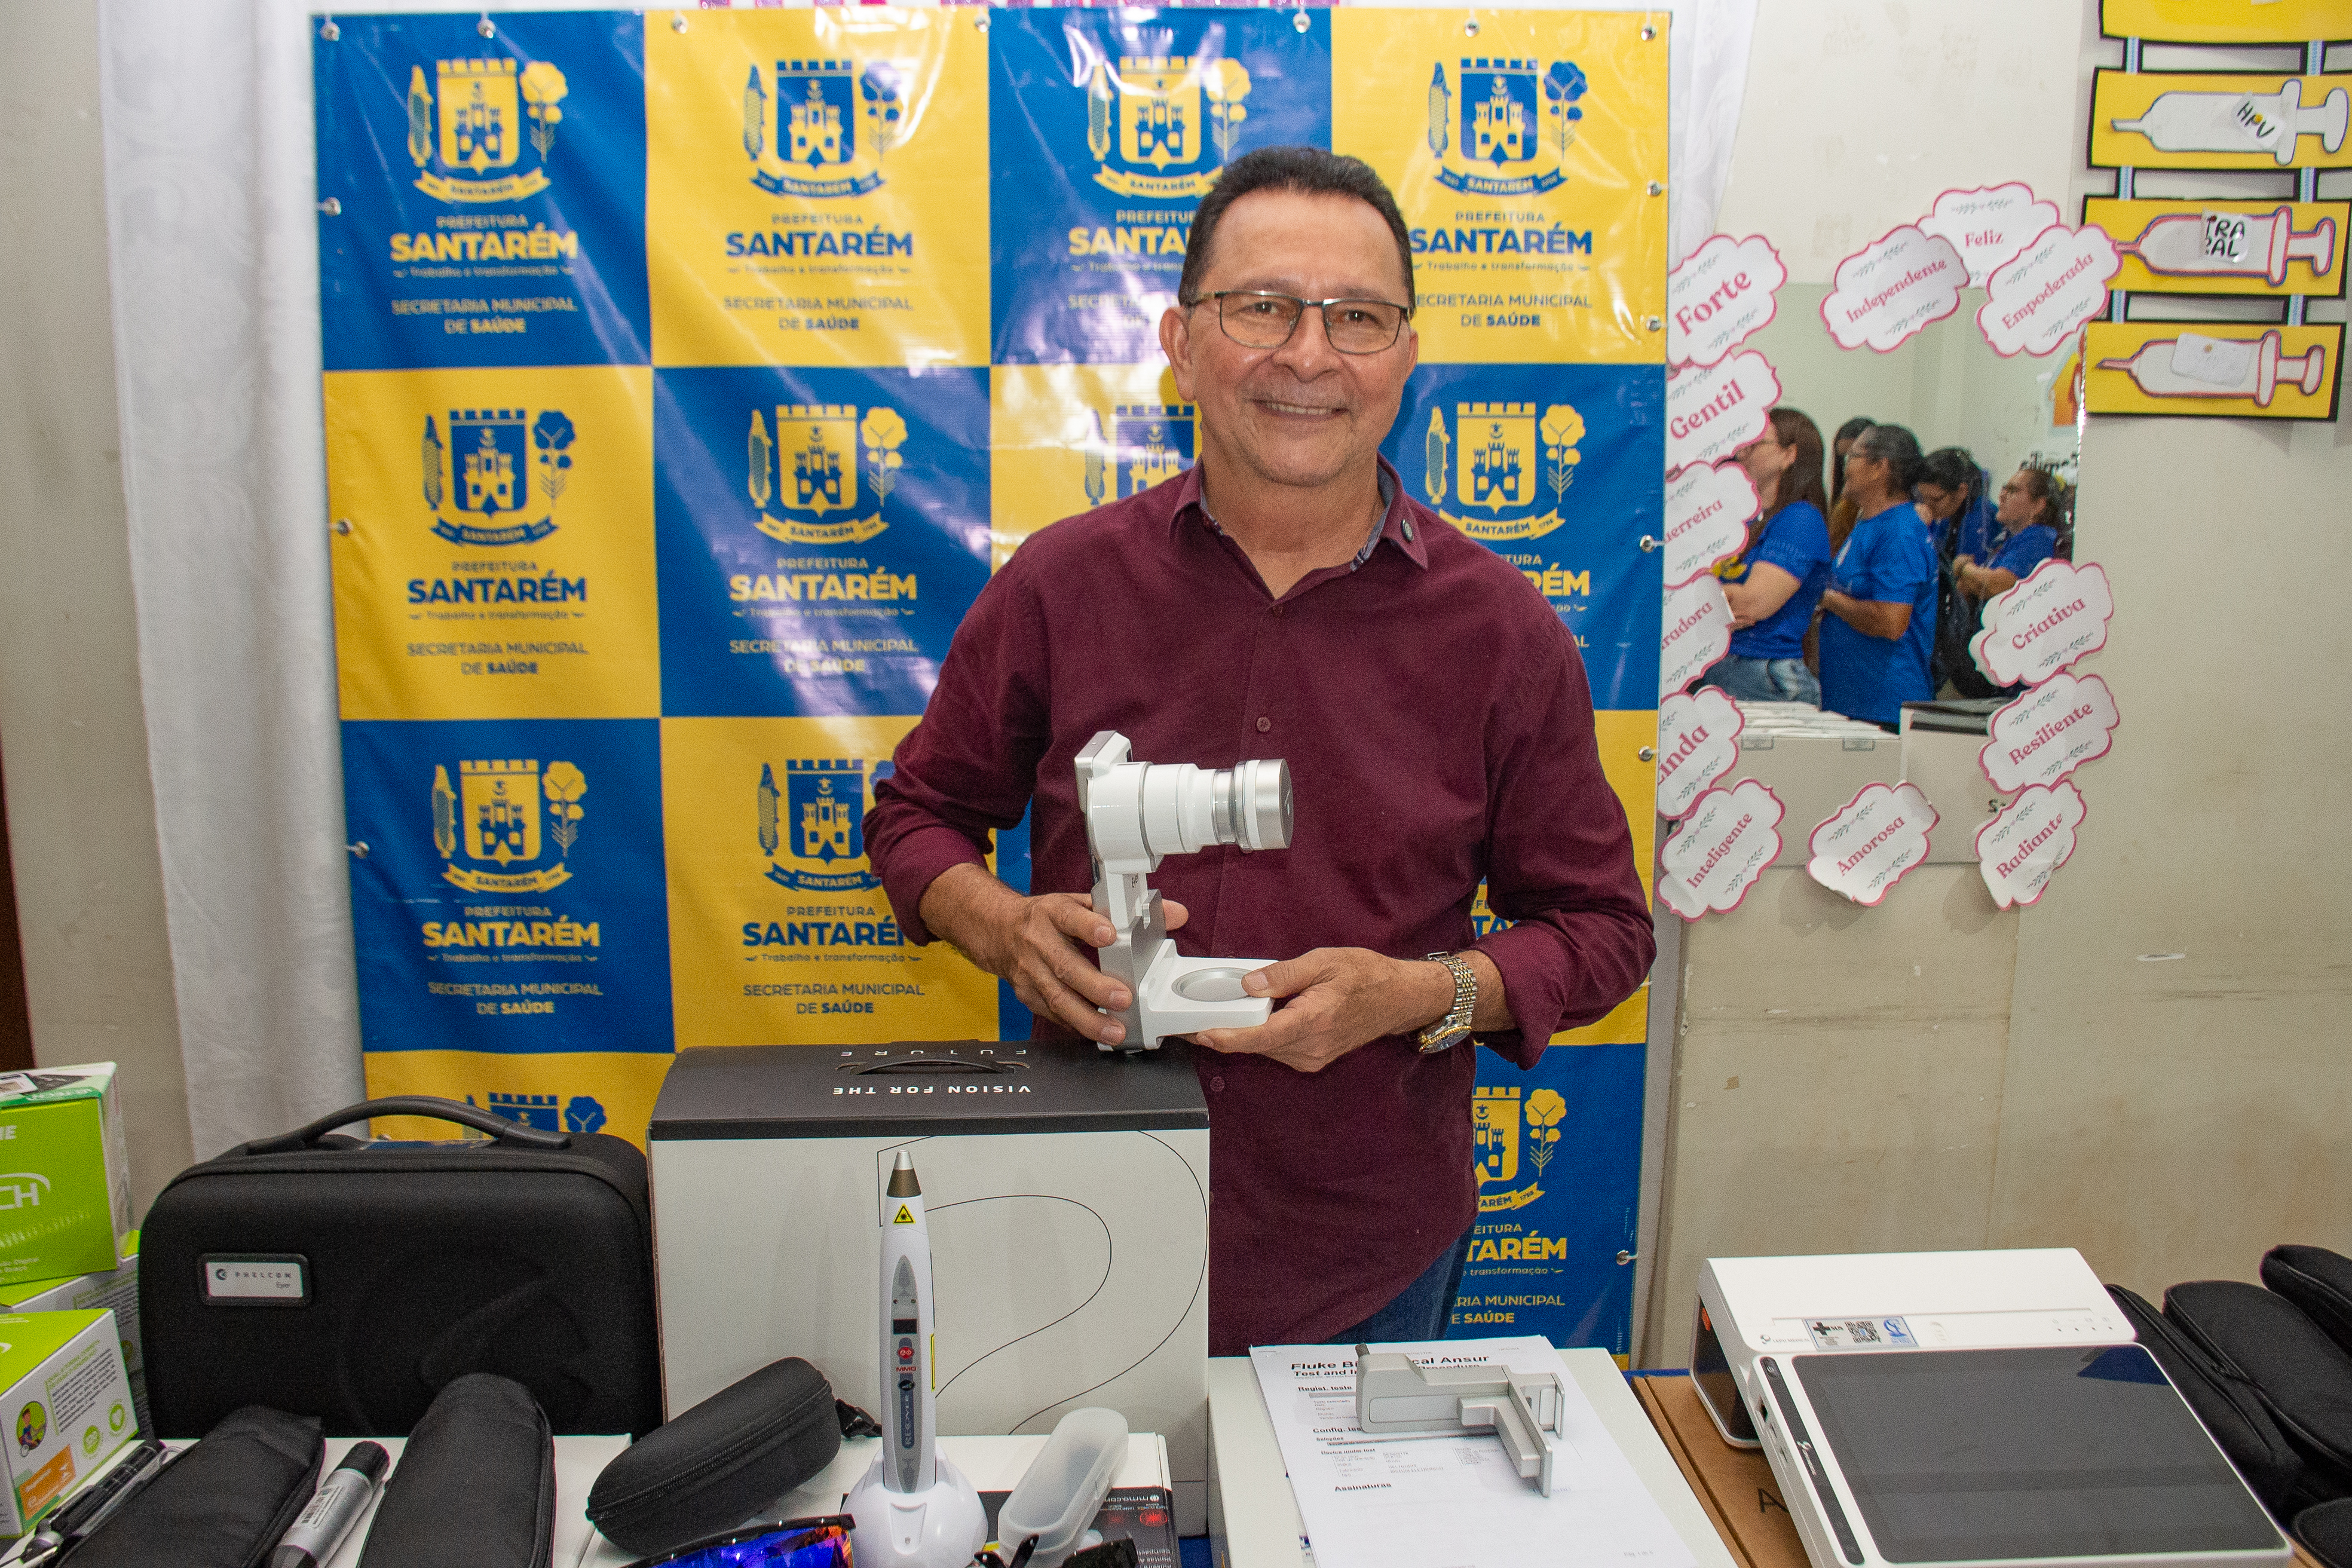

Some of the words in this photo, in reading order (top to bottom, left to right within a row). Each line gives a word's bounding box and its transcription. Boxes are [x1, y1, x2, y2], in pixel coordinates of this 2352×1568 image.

[1468, 177, 1533, 191] SANTARÉM
[436, 215, 528, 229] PREFEITURA
[771, 213, 863, 224] PREFEITURA
[1116, 210, 1196, 223] PREFEITU
[1456, 211, 1544, 222] PREFEITURA
[390, 223, 578, 262] SANTARÉM
[725, 224, 913, 257] SANTARÉM
[1069, 226, 1191, 255] SANTA
[1408, 222, 1592, 255] SANTARÉM
[1965, 230, 2004, 247] Feliz
[1428, 261, 1477, 270] Trabalho
[1491, 261, 1574, 274] transformação
[1845, 259, 1947, 323] Independente
[2001, 253, 2093, 330] Empoderada
[391, 299, 489, 314] SECRETARIA
[493, 298, 577, 313] MUNICIPAL
[724, 296, 822, 310] SECRETARIA
[826, 296, 914, 310] MUNICIPAL
[1416, 293, 1504, 308] ECRETARIA
[1509, 295, 1592, 308] MUNICIPAL
[1674, 270, 1751, 336] Forte
[445, 320, 467, 333] DE
[470, 316, 526, 333] SAÚDE
[779, 318, 800, 330] DE
[806, 314, 859, 330] SAÚDE
[1461, 316, 1481, 327] DE
[1486, 309, 1540, 327] SAÚDE
[1670, 379, 1746, 440] Gentil
[1466, 522, 1531, 534] SANTARÉM
[1664, 500, 1723, 543] uerreira
[790, 525, 853, 537] SANTARÉM
[451, 562, 537, 571] PREFEITURA
[777, 558, 868, 569] PREFEITURA
[407, 570, 587, 604] SANTARÉM
[729, 567, 917, 601] SANTARÉM
[2012, 598, 2086, 651] Criativa
[406, 642, 501, 656] SECRETARIA
[506, 642, 589, 654] MUNICIPAL
[730, 641, 829, 654] SECRETARIA
[832, 639, 918, 652] MUNICIPAL
[461, 662, 481, 675] DE
[488, 659, 537, 674] SAÚDE
[784, 660, 805, 672] DE
[810, 657, 865, 672] SAÚDE
[2008, 701, 2094, 767] Resiliente
[1687, 812, 1753, 889] Inteligente
[1837, 814, 1905, 876] Amorosa
[1996, 812, 2063, 879] Radiante
[476, 875, 537, 887] SANTARÉM
[798, 874, 862, 887] SANTARÉM
[465, 906, 552, 917] PREFEITURA
[786, 906, 875, 916] PREFEITURA
[423, 915, 599, 947] SANTARÉM
[761, 953, 810, 962] Trabalho
[823, 953, 904, 963] transformação
[428, 982, 517, 996] SECRETARIA
[521, 983, 602, 996] MUNICIPAL
[743, 983, 837, 996] SECRETARIA
[841, 984, 924, 996] MUNICIPAL
[477, 1002, 497, 1015] DE
[501, 999, 554, 1014] SAÚDE
[797, 1003, 817, 1014] DE
[821, 999, 874, 1013] SAÚDE
[832, 1086, 876, 1095] THE
[1481, 1196, 1512, 1208] ARÉM
[1474, 1224, 1522, 1234] EITURA
[1466, 1230, 1567, 1262] TARÉM
[1486, 1296, 1565, 1306] MUNICIPAL
[1465, 1310, 1514, 1324] SAÚDE
[1291, 1361, 1336, 1370] Fluke
[1441, 1355, 1490, 1363] Ansur
[1334, 1483, 1392, 1492] Assinaturas
